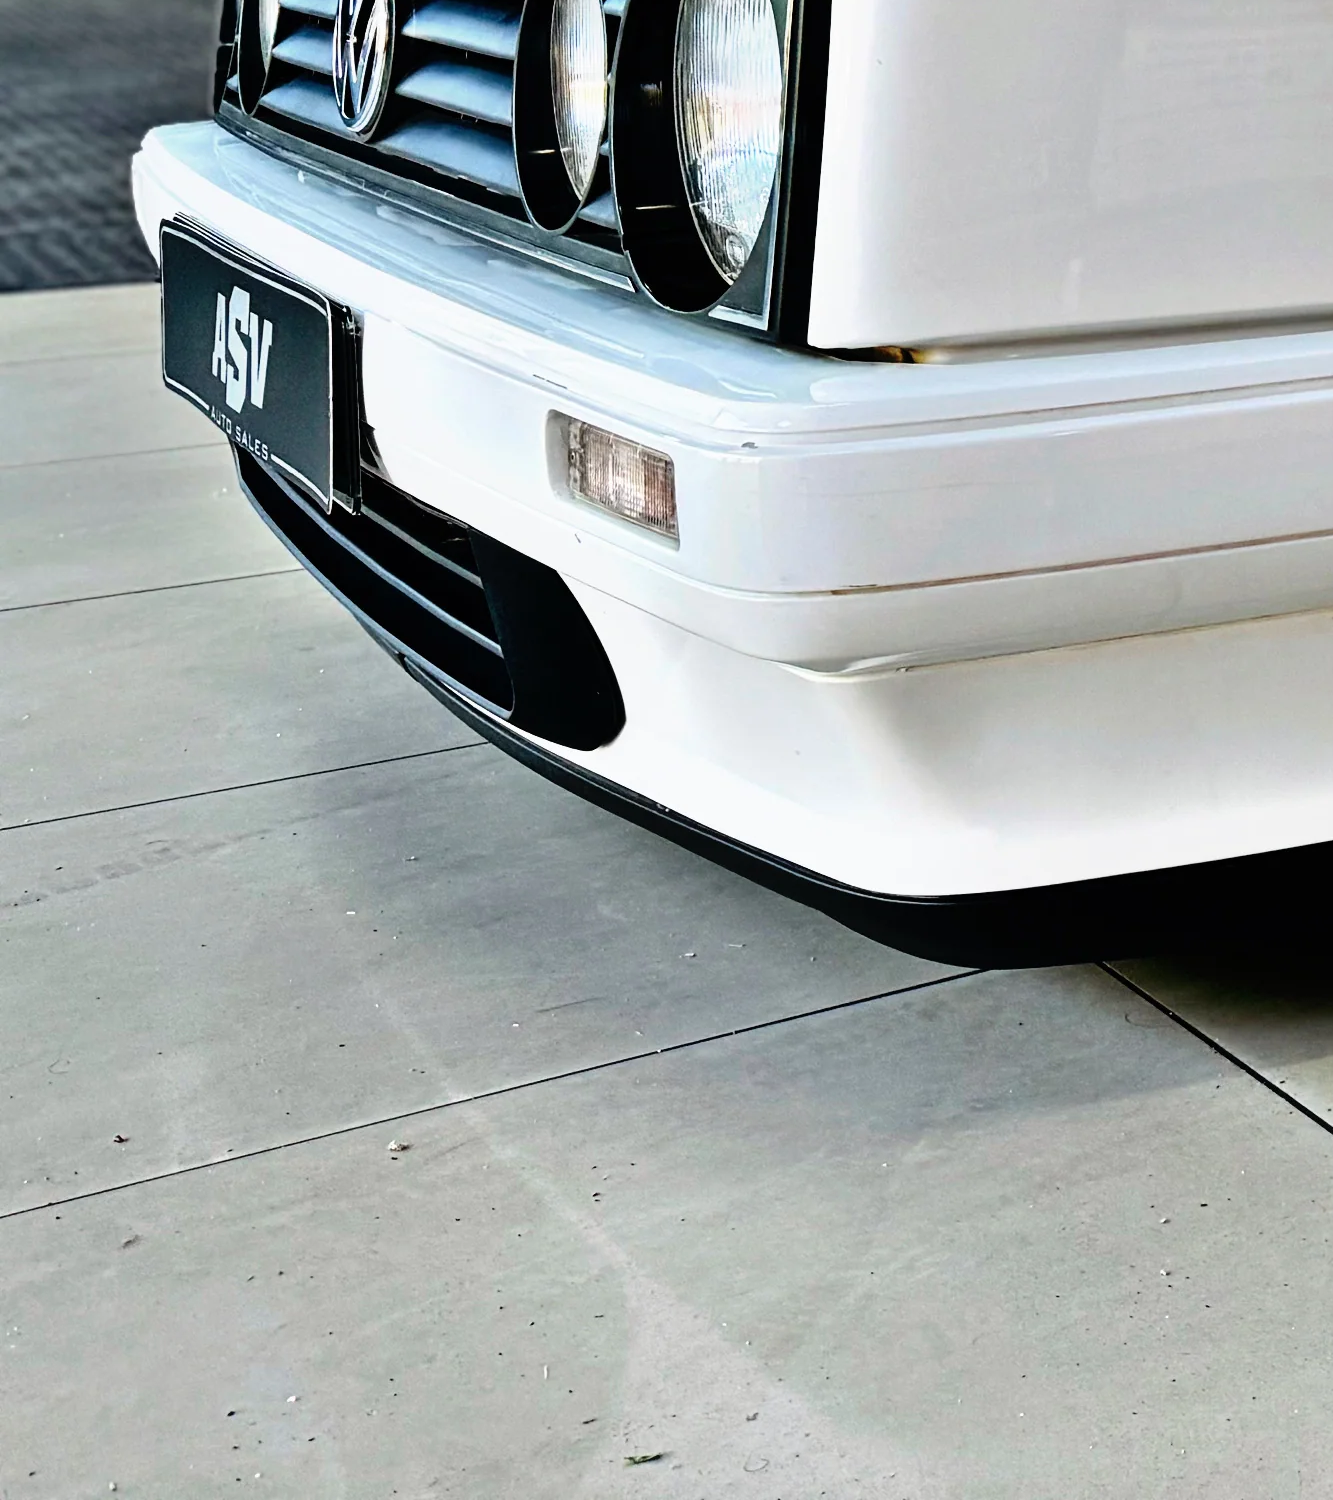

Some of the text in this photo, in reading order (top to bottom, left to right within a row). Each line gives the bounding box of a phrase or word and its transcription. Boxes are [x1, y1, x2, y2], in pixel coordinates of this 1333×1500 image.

[212, 286, 273, 414] ASV
[211, 405, 269, 461] AUTO SALES
